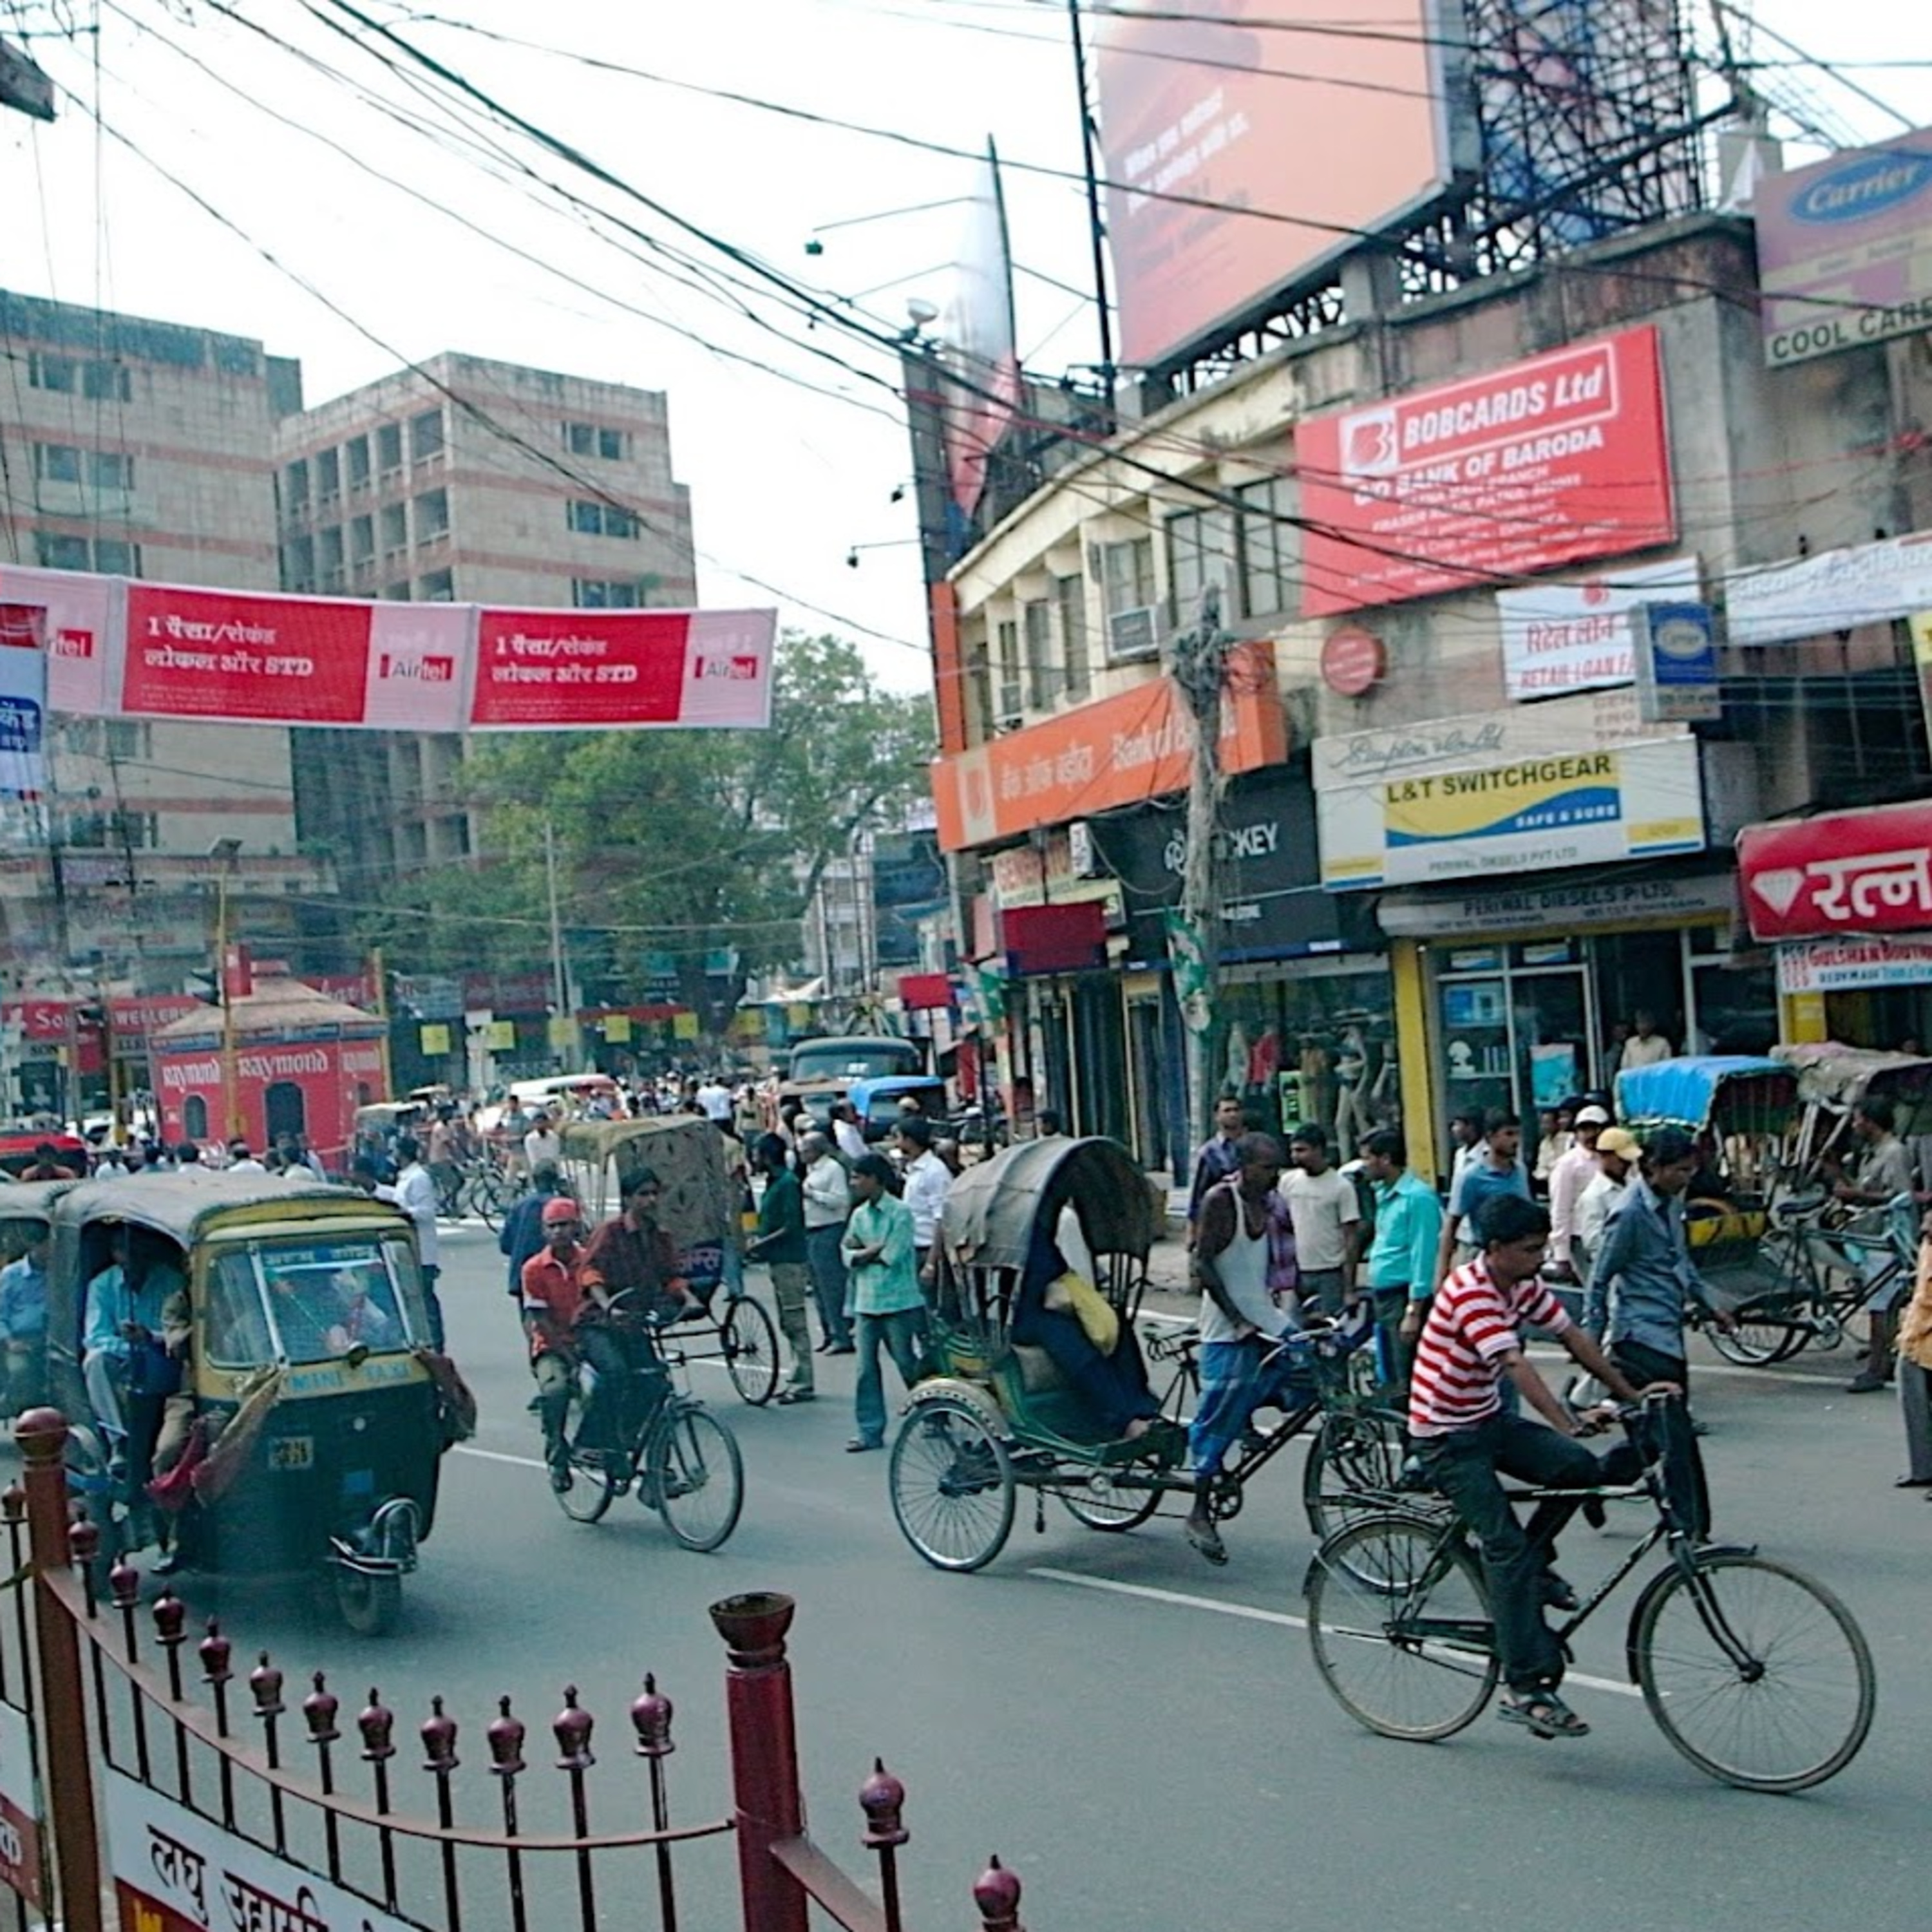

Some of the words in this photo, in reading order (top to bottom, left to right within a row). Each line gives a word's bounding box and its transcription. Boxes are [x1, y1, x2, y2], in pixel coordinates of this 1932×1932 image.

[1807, 160, 1920, 213] Carrier
[1772, 321, 1848, 359] COOL
[1859, 296, 1932, 336] CARE
[1403, 383, 1546, 450] BOBCARDS
[1553, 365, 1604, 410] Ltd
[1396, 462, 1459, 497] BANK
[1465, 453, 1496, 479] OF
[1502, 426, 1604, 471] BARODA
[148, 616, 160, 637] 1
[496, 636, 506, 656] 1
[220, 649, 262, 674] और
[264, 656, 314, 677] STD
[392, 659, 448, 680] Airtel
[595, 663, 638, 683] STD
[705, 661, 753, 680] Airtel
[1520, 663, 1570, 689] RETAIL
[1575, 656, 1613, 679] LOAN
[1112, 721, 1153, 771] Bank
[1387, 777, 1434, 804] L&T
[1442, 754, 1611, 797] SWITCHGEAR
[1515, 808, 1555, 829] SAFE
[1559, 809, 1571, 822] &
[1574, 804, 1617, 821] SURE
[1229, 824, 1279, 858] KEY
[1530, 849, 1554, 864] PVT
[1555, 846, 1578, 861] LTD
[1806, 847, 1932, 921] रत्न
[1463, 894, 1535, 917] PERIWAL
[1540, 886, 1616, 909] DIESELS
[114, 1007, 191, 1026] WELLERS
[162, 1057, 221, 1093] Raymond
[237, 1048, 329, 1082] Raymond
[146, 1823, 209, 1927] लघु
